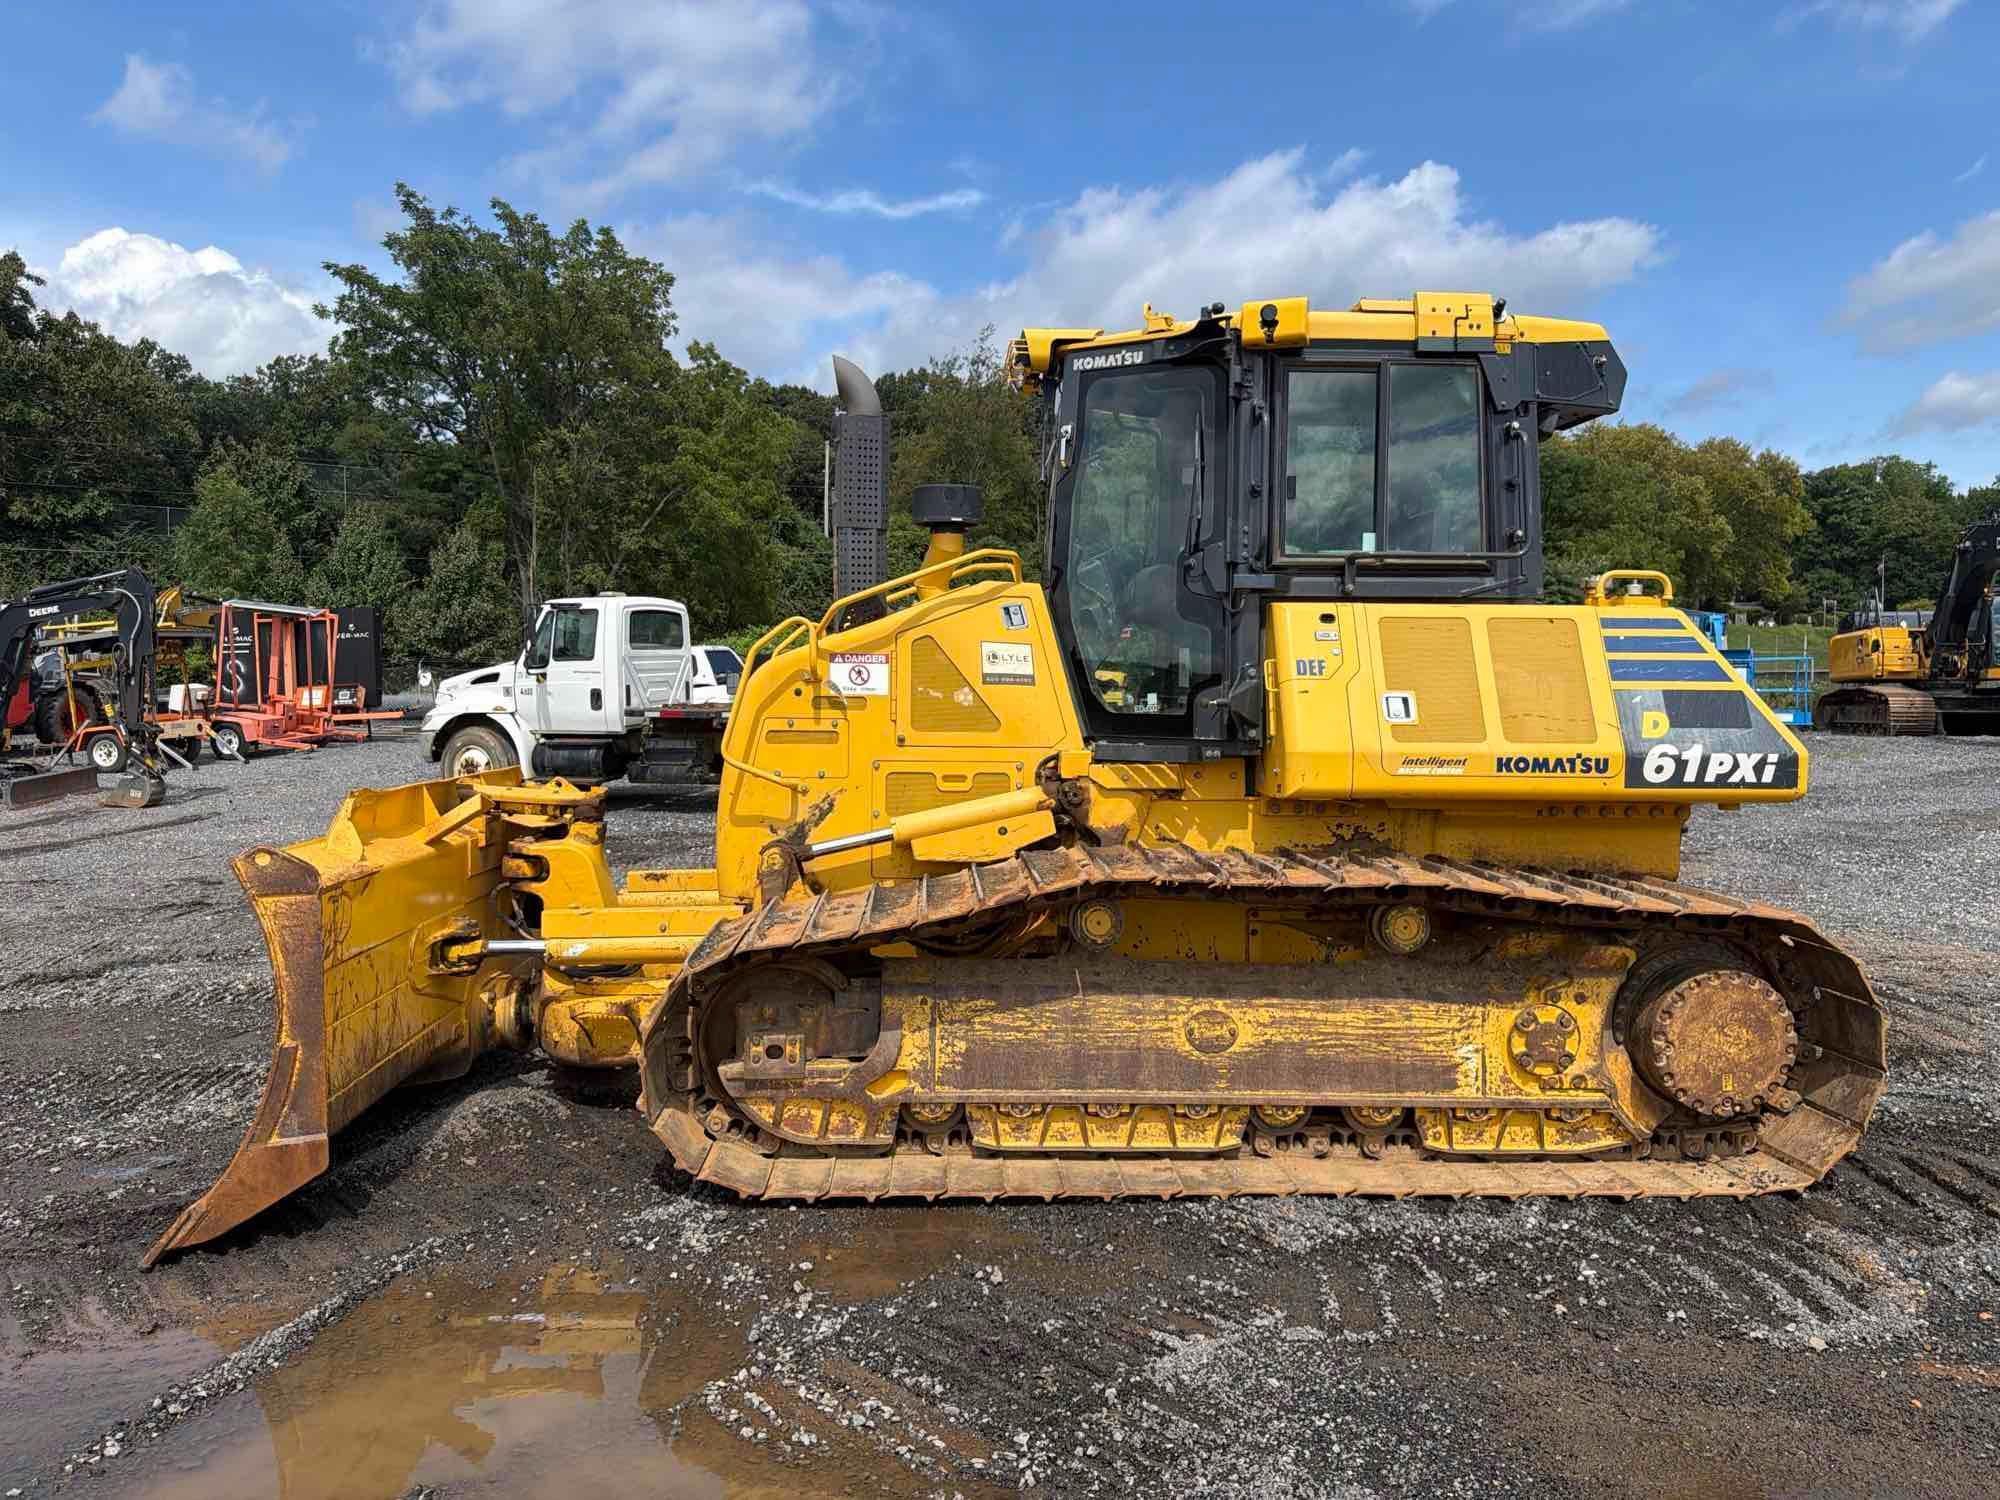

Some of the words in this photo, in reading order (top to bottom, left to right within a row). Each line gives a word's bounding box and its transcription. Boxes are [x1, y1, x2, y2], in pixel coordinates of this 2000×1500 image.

[1073, 350, 1144, 370] KOMATSU
[29, 605, 60, 617] DEERE
[845, 655, 886, 663] DANGER
[1001, 654, 1031, 663] LYLE
[1296, 659, 1326, 676] DEF
[1642, 711, 1670, 738] D
[1402, 756, 1468, 768] intelligent
[1496, 753, 1609, 774] KOMATSU
[1643, 743, 1779, 783] 61PXi
